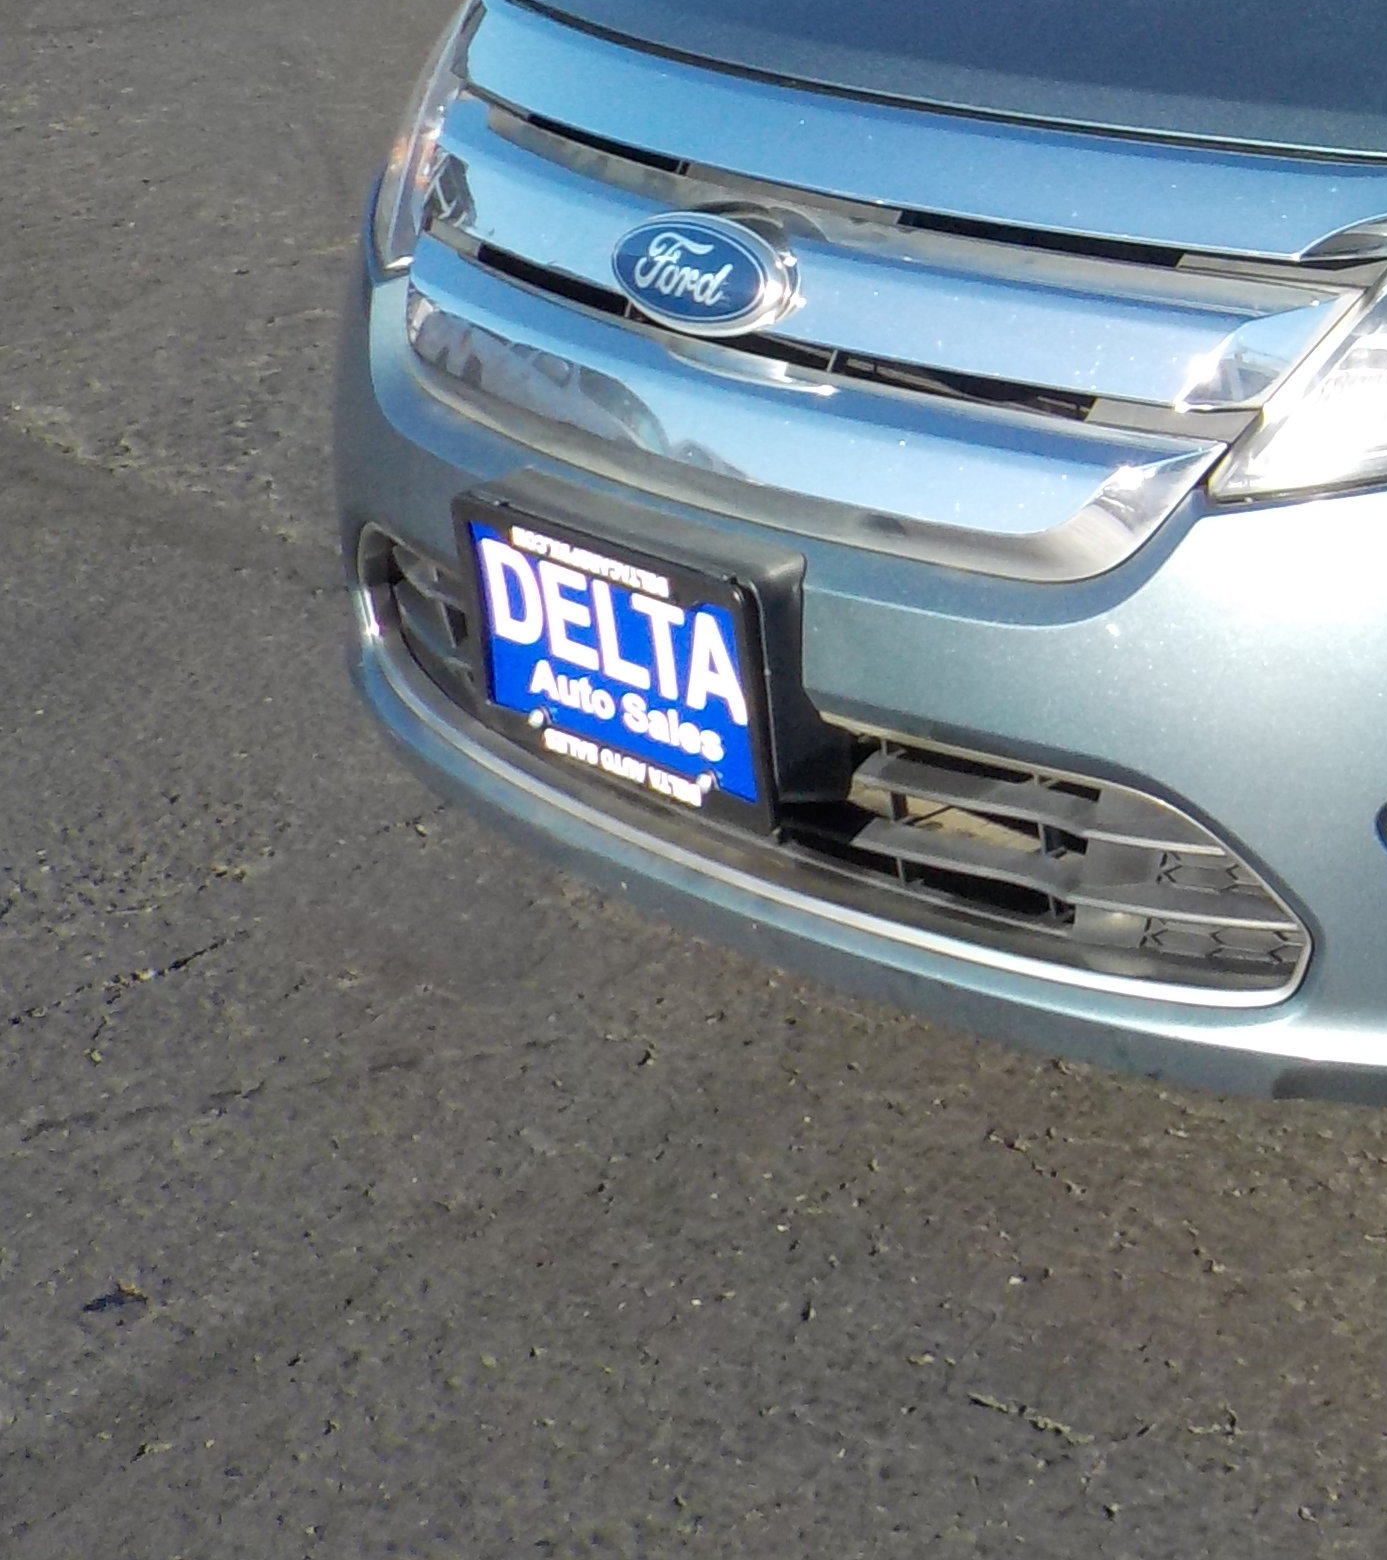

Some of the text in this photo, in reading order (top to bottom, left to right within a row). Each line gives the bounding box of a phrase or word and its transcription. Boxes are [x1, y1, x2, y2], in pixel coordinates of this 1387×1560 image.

[634, 231, 734, 306] Ford
[481, 537, 749, 727] DELTA
[528, 659, 726, 763] Auto Sales
